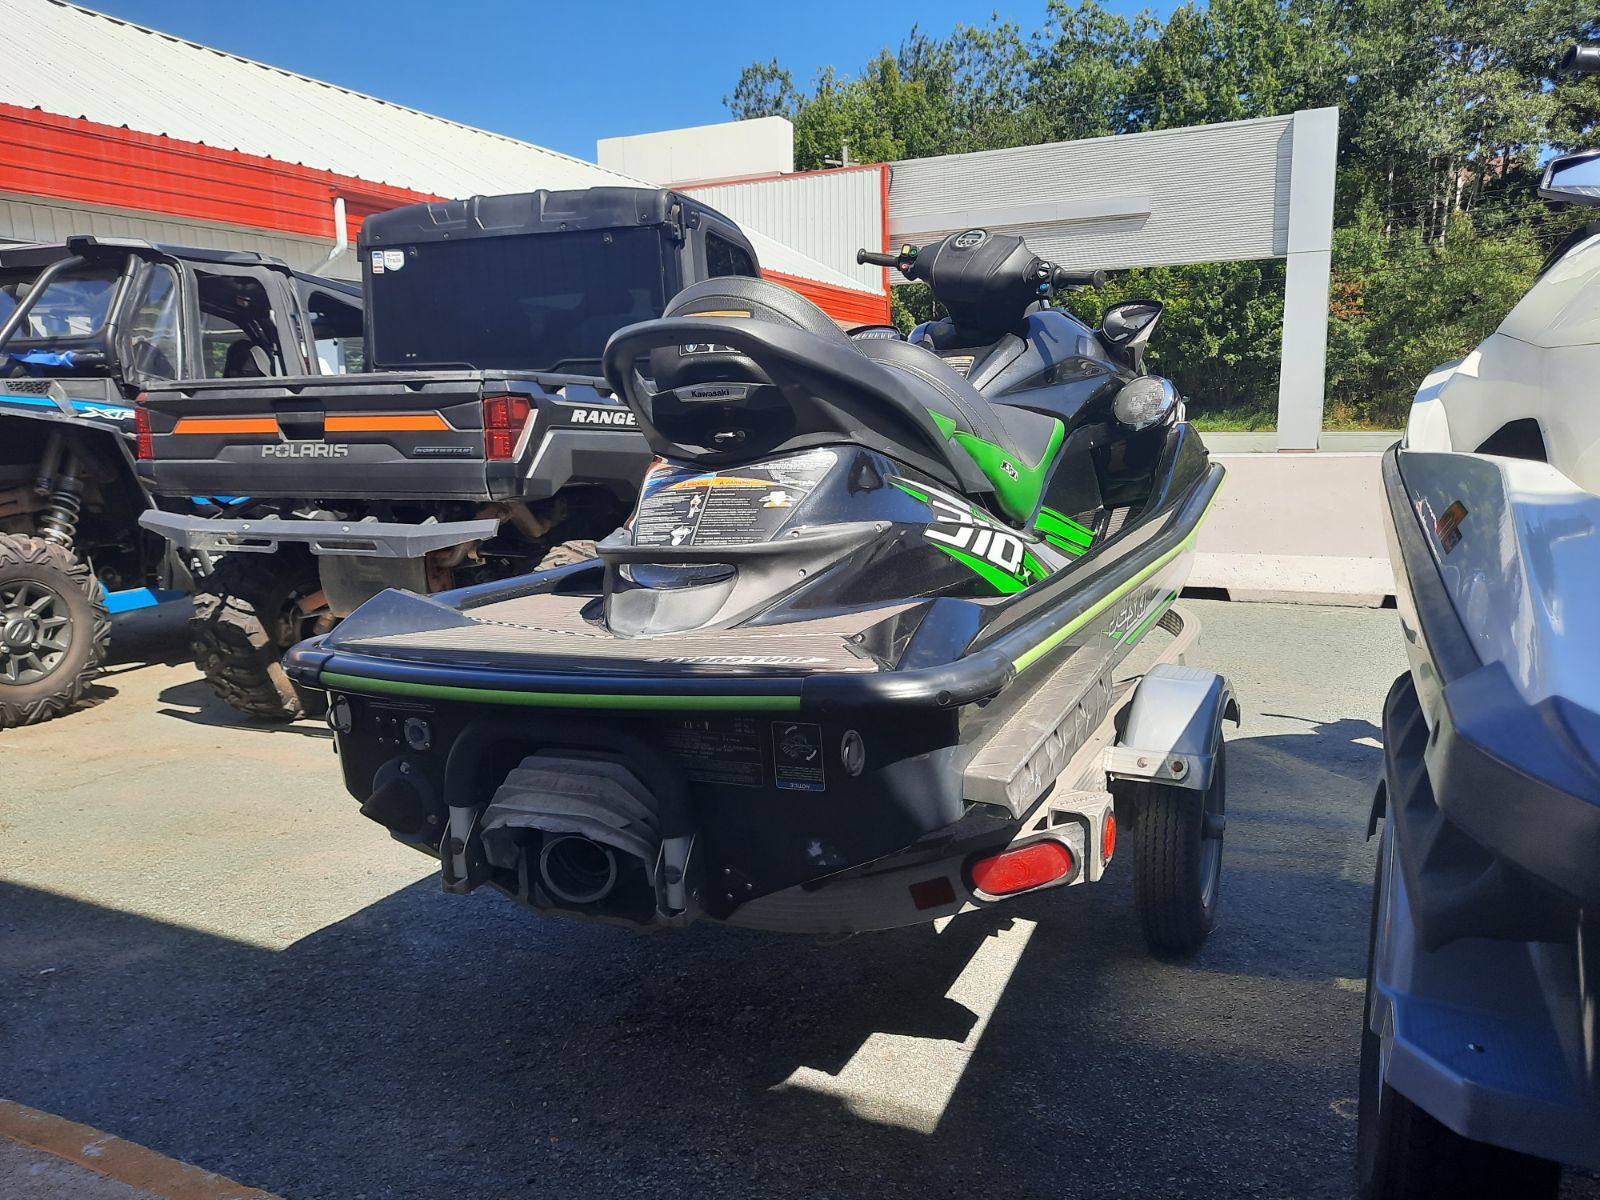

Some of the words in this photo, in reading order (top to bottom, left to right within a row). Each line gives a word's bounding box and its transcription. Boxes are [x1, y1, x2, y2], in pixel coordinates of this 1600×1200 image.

[691, 388, 730, 398] Kawasaki
[570, 409, 639, 426] RANGE
[261, 443, 348, 458] POLARIS
[924, 500, 1023, 573] 310
[660, 656, 813, 664] HYDRO-TURF
